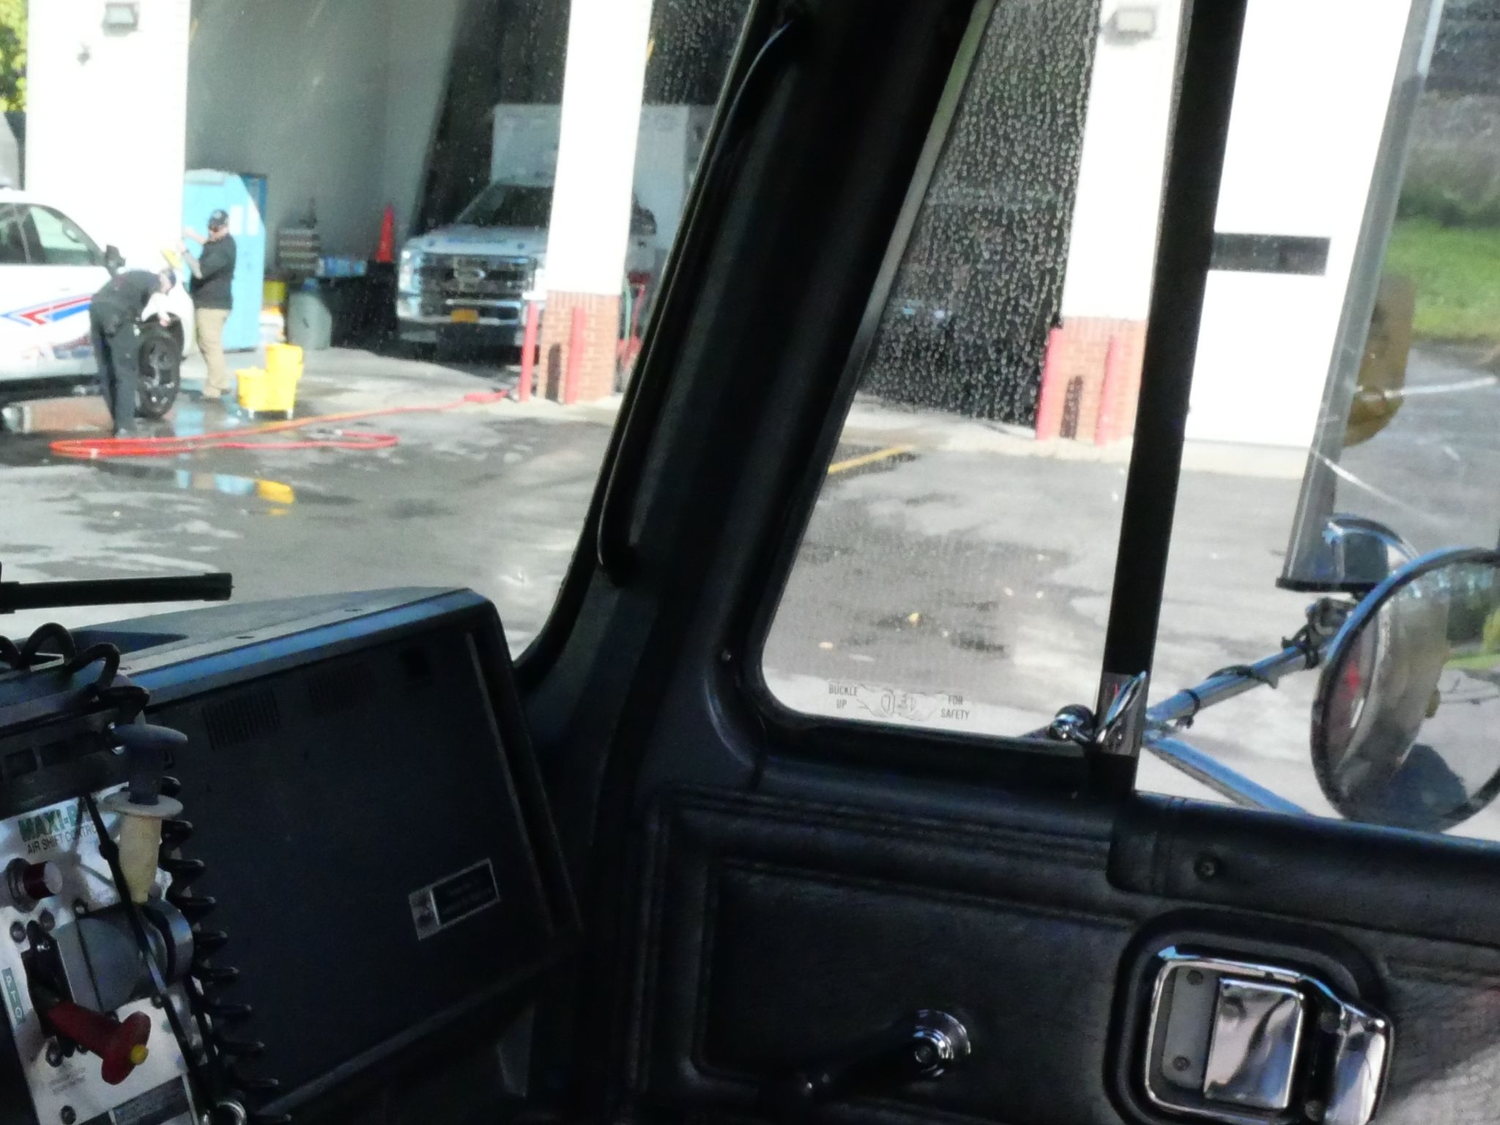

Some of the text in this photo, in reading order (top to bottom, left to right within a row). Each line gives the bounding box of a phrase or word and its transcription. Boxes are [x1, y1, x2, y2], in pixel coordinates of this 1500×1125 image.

[828, 683, 858, 697] BUCKLE
[836, 699, 847, 709] UP
[940, 707, 970, 720] SAFETY
[27, 840, 41, 855] AIR
